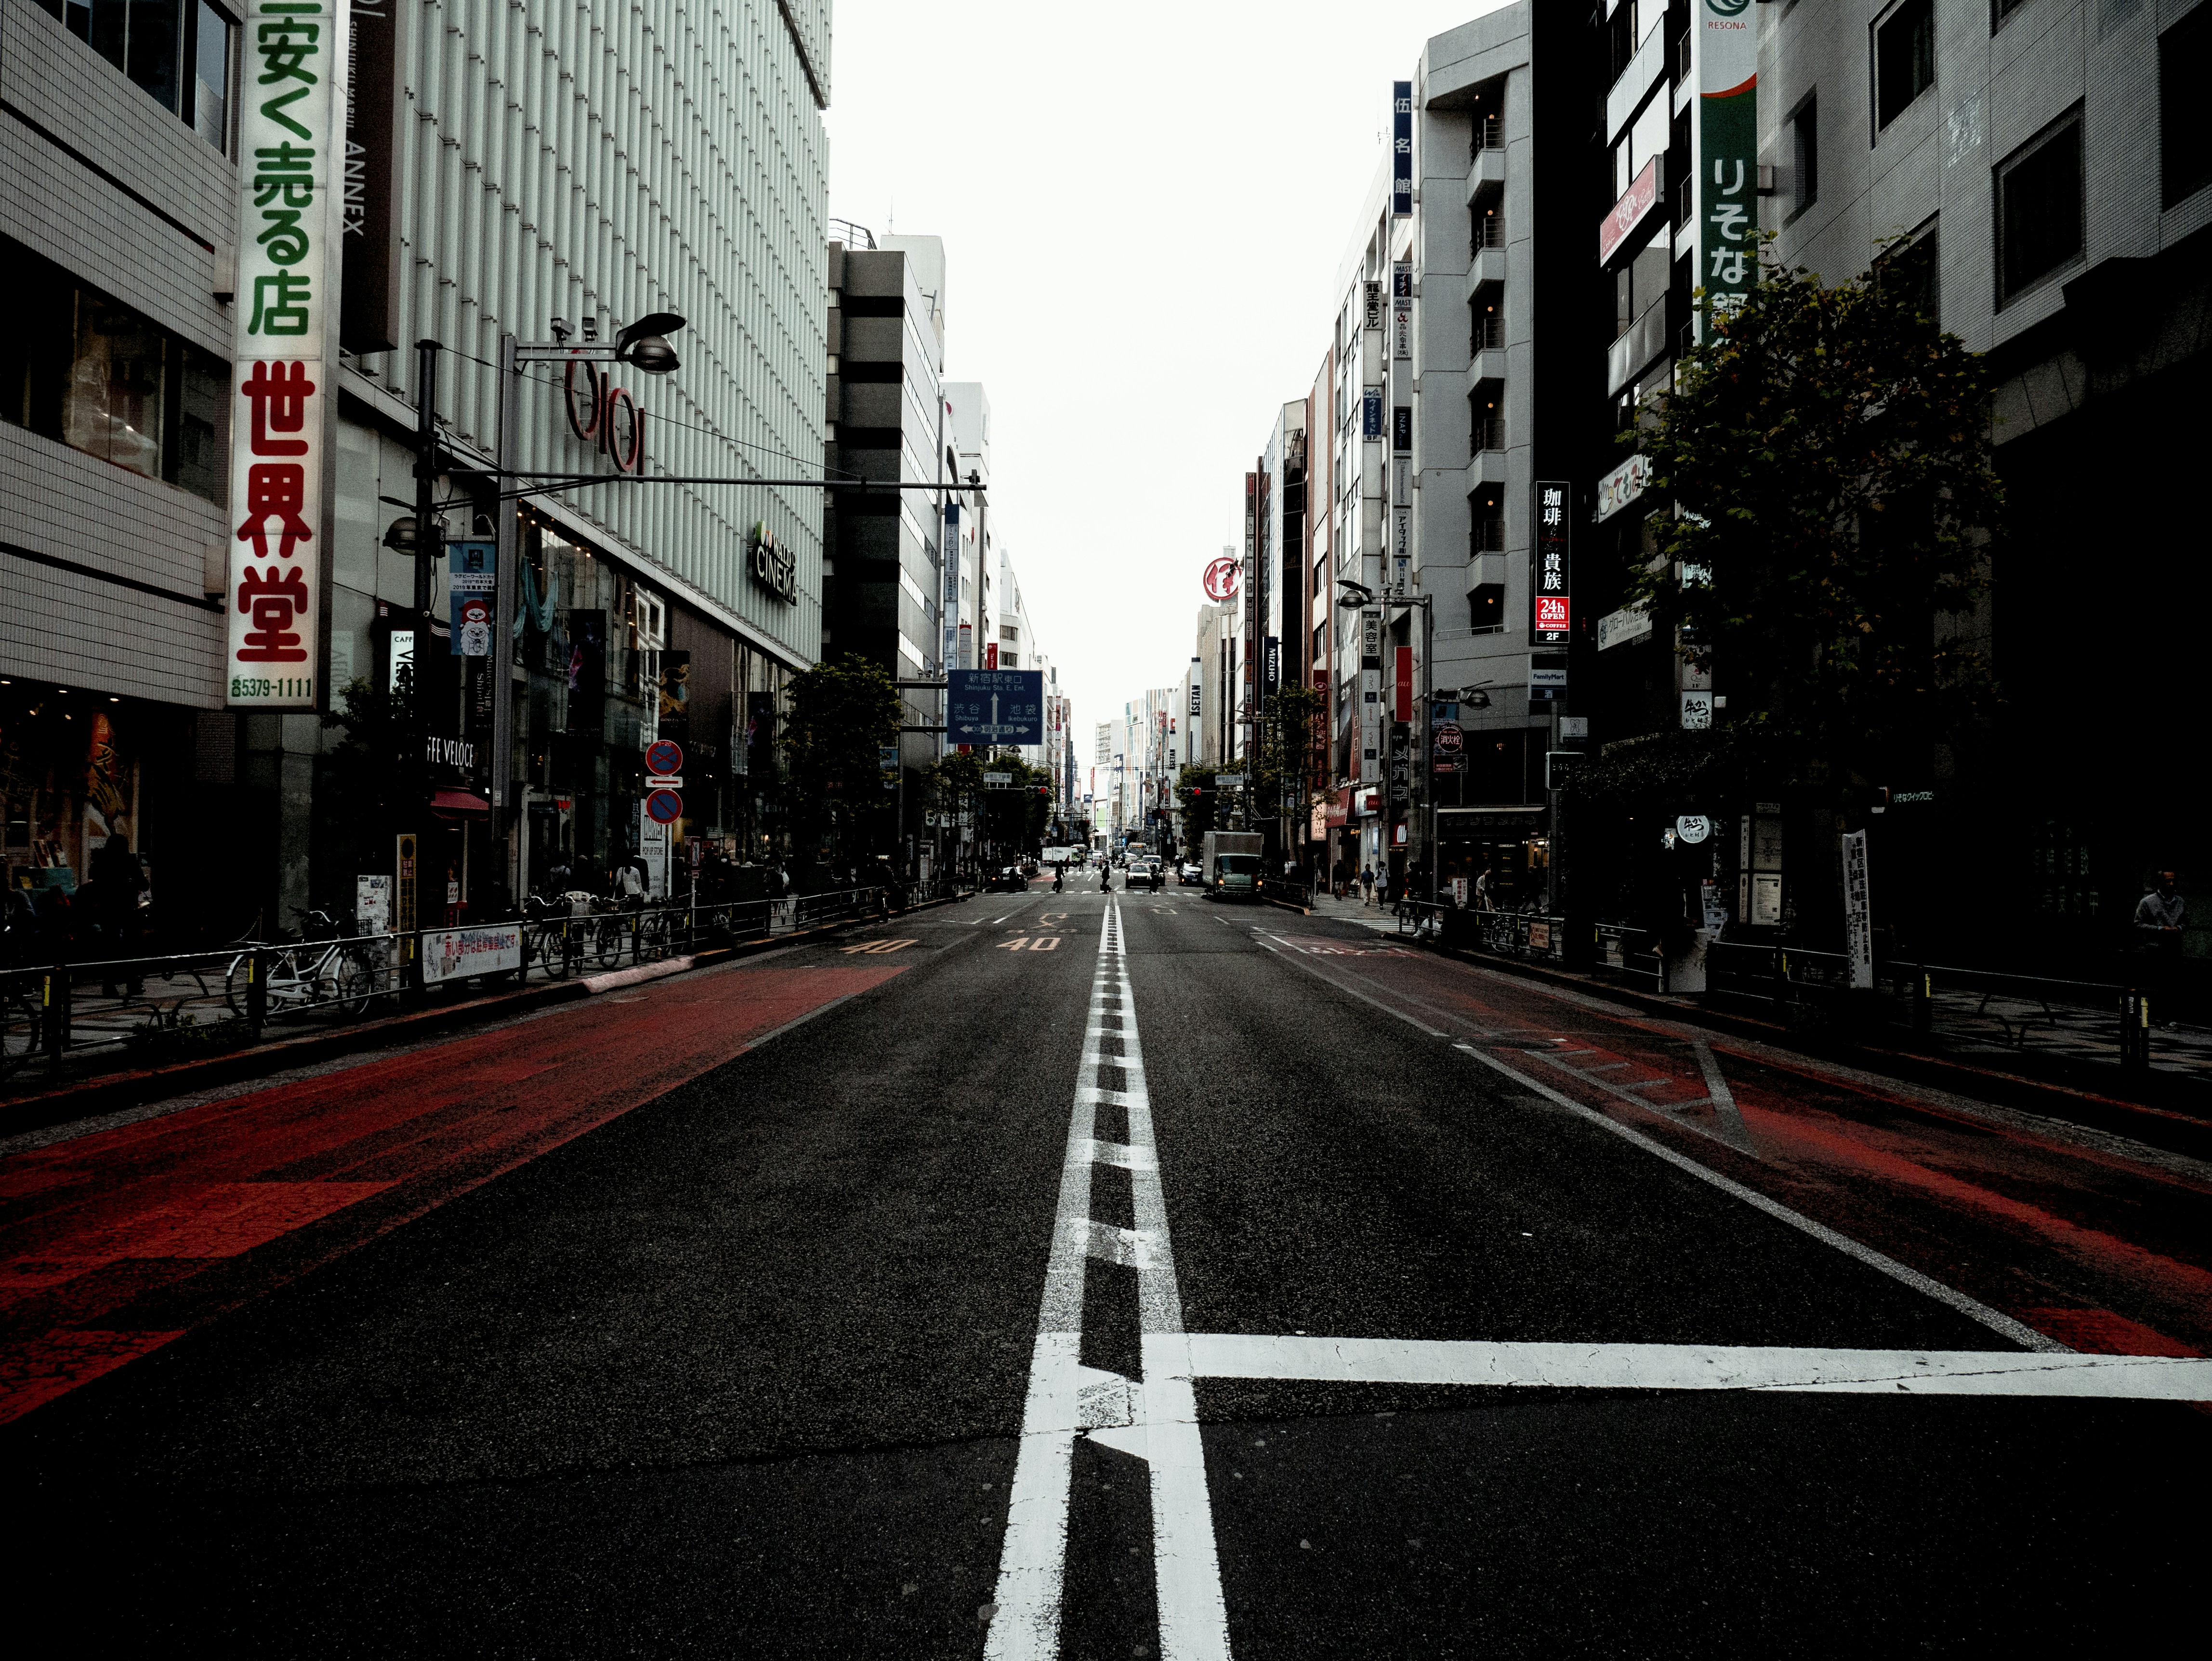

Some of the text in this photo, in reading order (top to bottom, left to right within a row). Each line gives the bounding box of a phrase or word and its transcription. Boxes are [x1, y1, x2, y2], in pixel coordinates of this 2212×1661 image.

[1708, 21, 1747, 30] RESONA
[1395, 97, 1411, 194] 伍名館
[343, 142, 366, 236] ANNEX
[1710, 159, 1749, 349] りそな銀
[1366, 283, 1380, 328] 龍王堂ビル
[1364, 387, 1380, 396] Win
[237, 361, 315, 662] 世界堂
[1543, 488, 1562, 526] 珈琲
[773, 535, 791, 567] WALD
[757, 544, 798, 606] CINEMA
[1543, 553, 1562, 590] 貴族
[1540, 599, 1565, 613] 24h
[1365, 620, 1377, 654] 美容室
[241, 678, 311, 698] 5379-1111
[969, 673, 1022, 684] 新宿駅東口
[1190, 685, 1201, 716] ISETAN
[1544, 689, 1554, 699] 酒
[954, 703, 980, 715] 渋谷
[1010, 704, 1037, 715] 池袋
[1685, 699, 1709, 716] 牛かつ
[1440, 734, 1460, 745] 消火栓
[444, 739, 474, 768] VELOCE
[1393, 745, 1408, 802] メガネ
[1684, 817, 1704, 831] 牛かつ
[653, 846, 663, 856] STORE
[839, 939, 919, 954] 40
[996, 937, 1061, 951] 40
